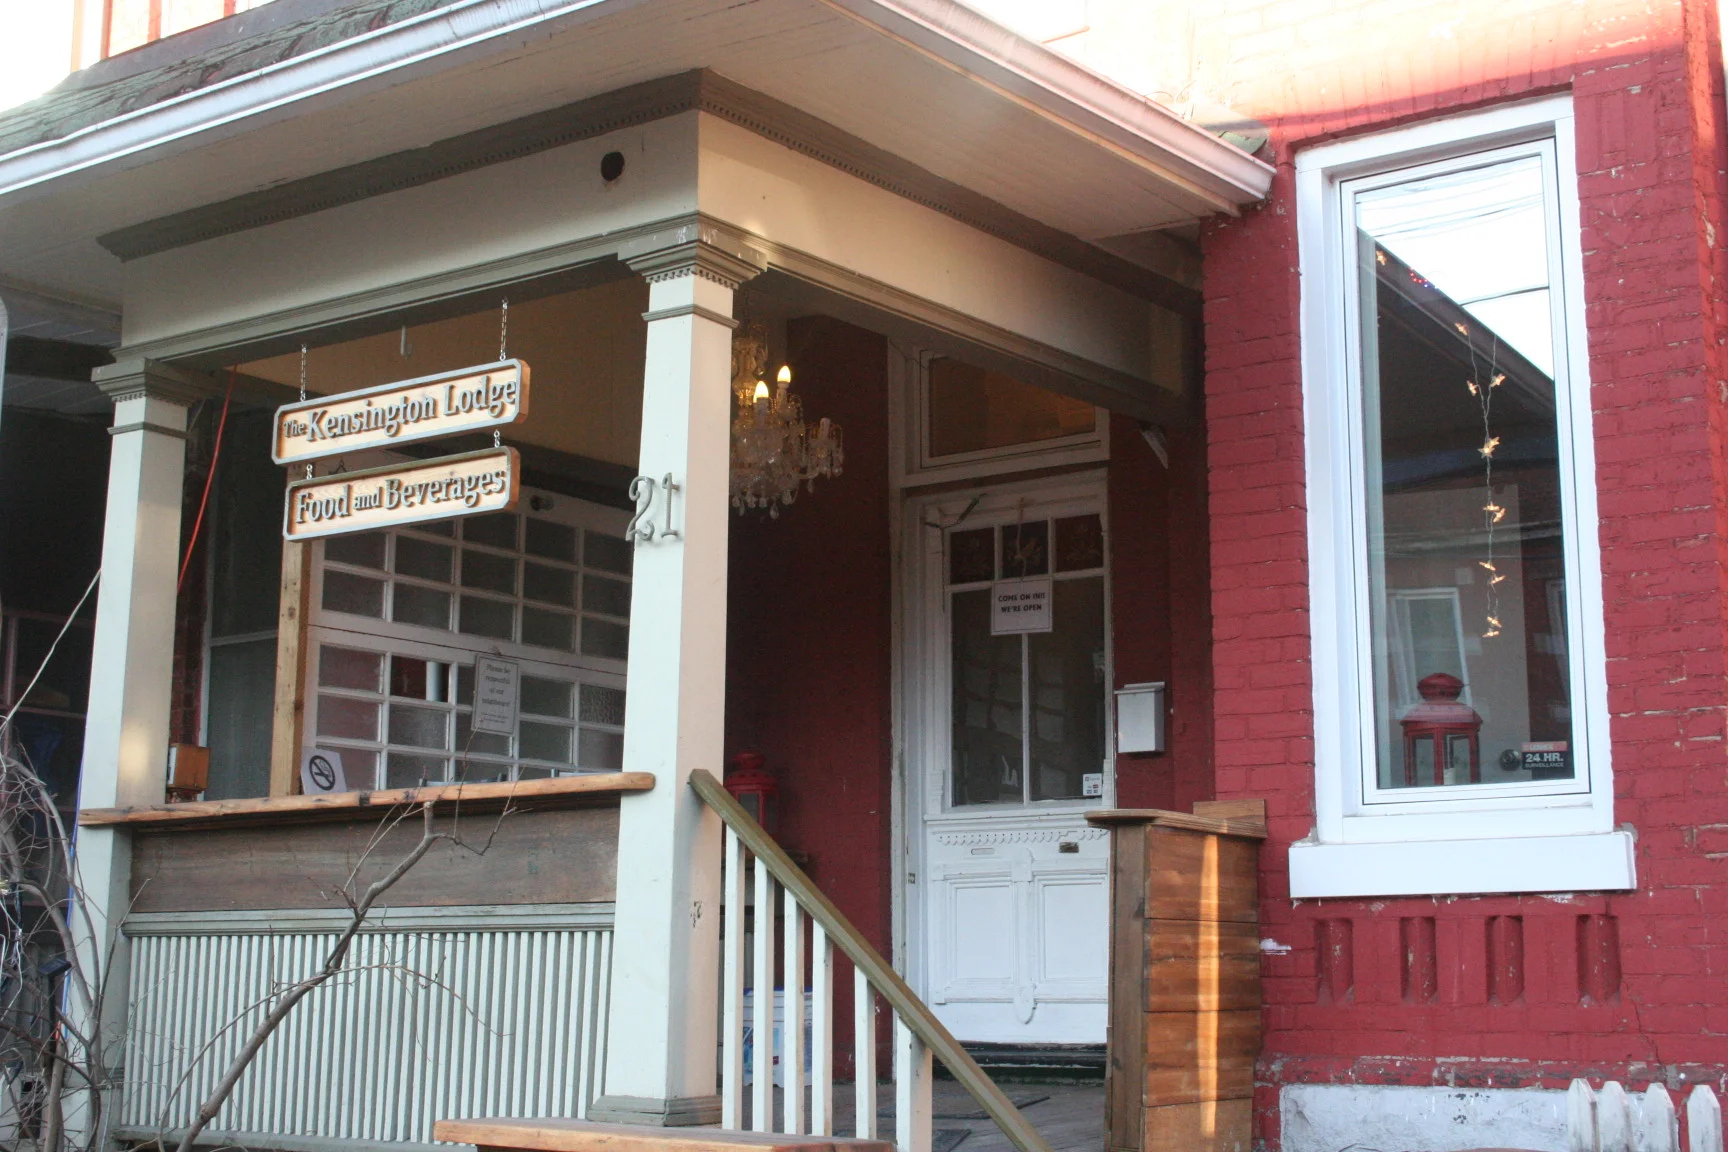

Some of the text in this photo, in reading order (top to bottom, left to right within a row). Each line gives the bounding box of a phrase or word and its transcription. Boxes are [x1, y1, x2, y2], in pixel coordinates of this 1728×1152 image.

[283, 375, 517, 442] The Kensington Lodge
[295, 469, 506, 524] Food and Beverages
[625, 472, 681, 542] 21
[998, 594, 1018, 602] COME
[1001, 604, 1021, 613] WE'RE
[1525, 752, 1564, 762] 24 HR.
